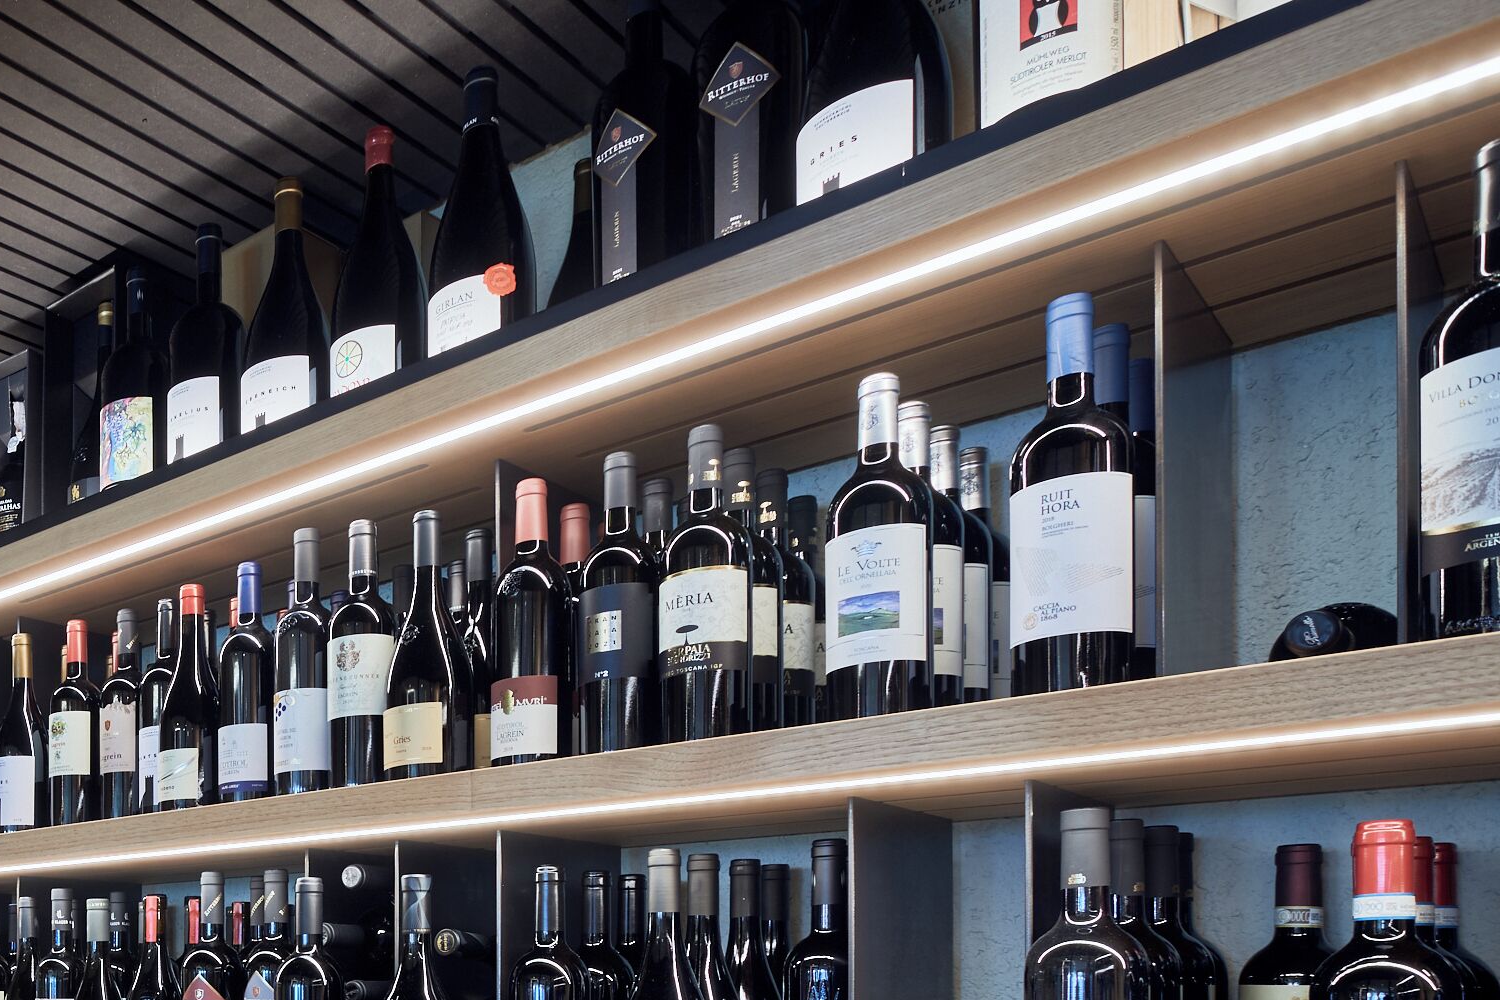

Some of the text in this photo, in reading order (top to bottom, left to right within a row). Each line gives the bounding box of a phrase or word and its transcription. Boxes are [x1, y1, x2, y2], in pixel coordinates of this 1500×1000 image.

[1056, 51, 1088, 67] MERLOT
[707, 72, 770, 102] RITTERHOF
[596, 133, 645, 166] RITTERHOF
[810, 134, 858, 166] GRIES
[435, 291, 475, 315] GIRLAN
[1428, 383, 1463, 404] VILLA
[1041, 488, 1074, 505] RUIT
[1041, 499, 1081, 516] HORA
[837, 557, 901, 578] LE VOLTE
[1033, 602, 1060, 612] CACCIA
[1051, 604, 1077, 614] PIANO
[393, 735, 412, 745] Gries
[102, 752, 122, 763] grein
